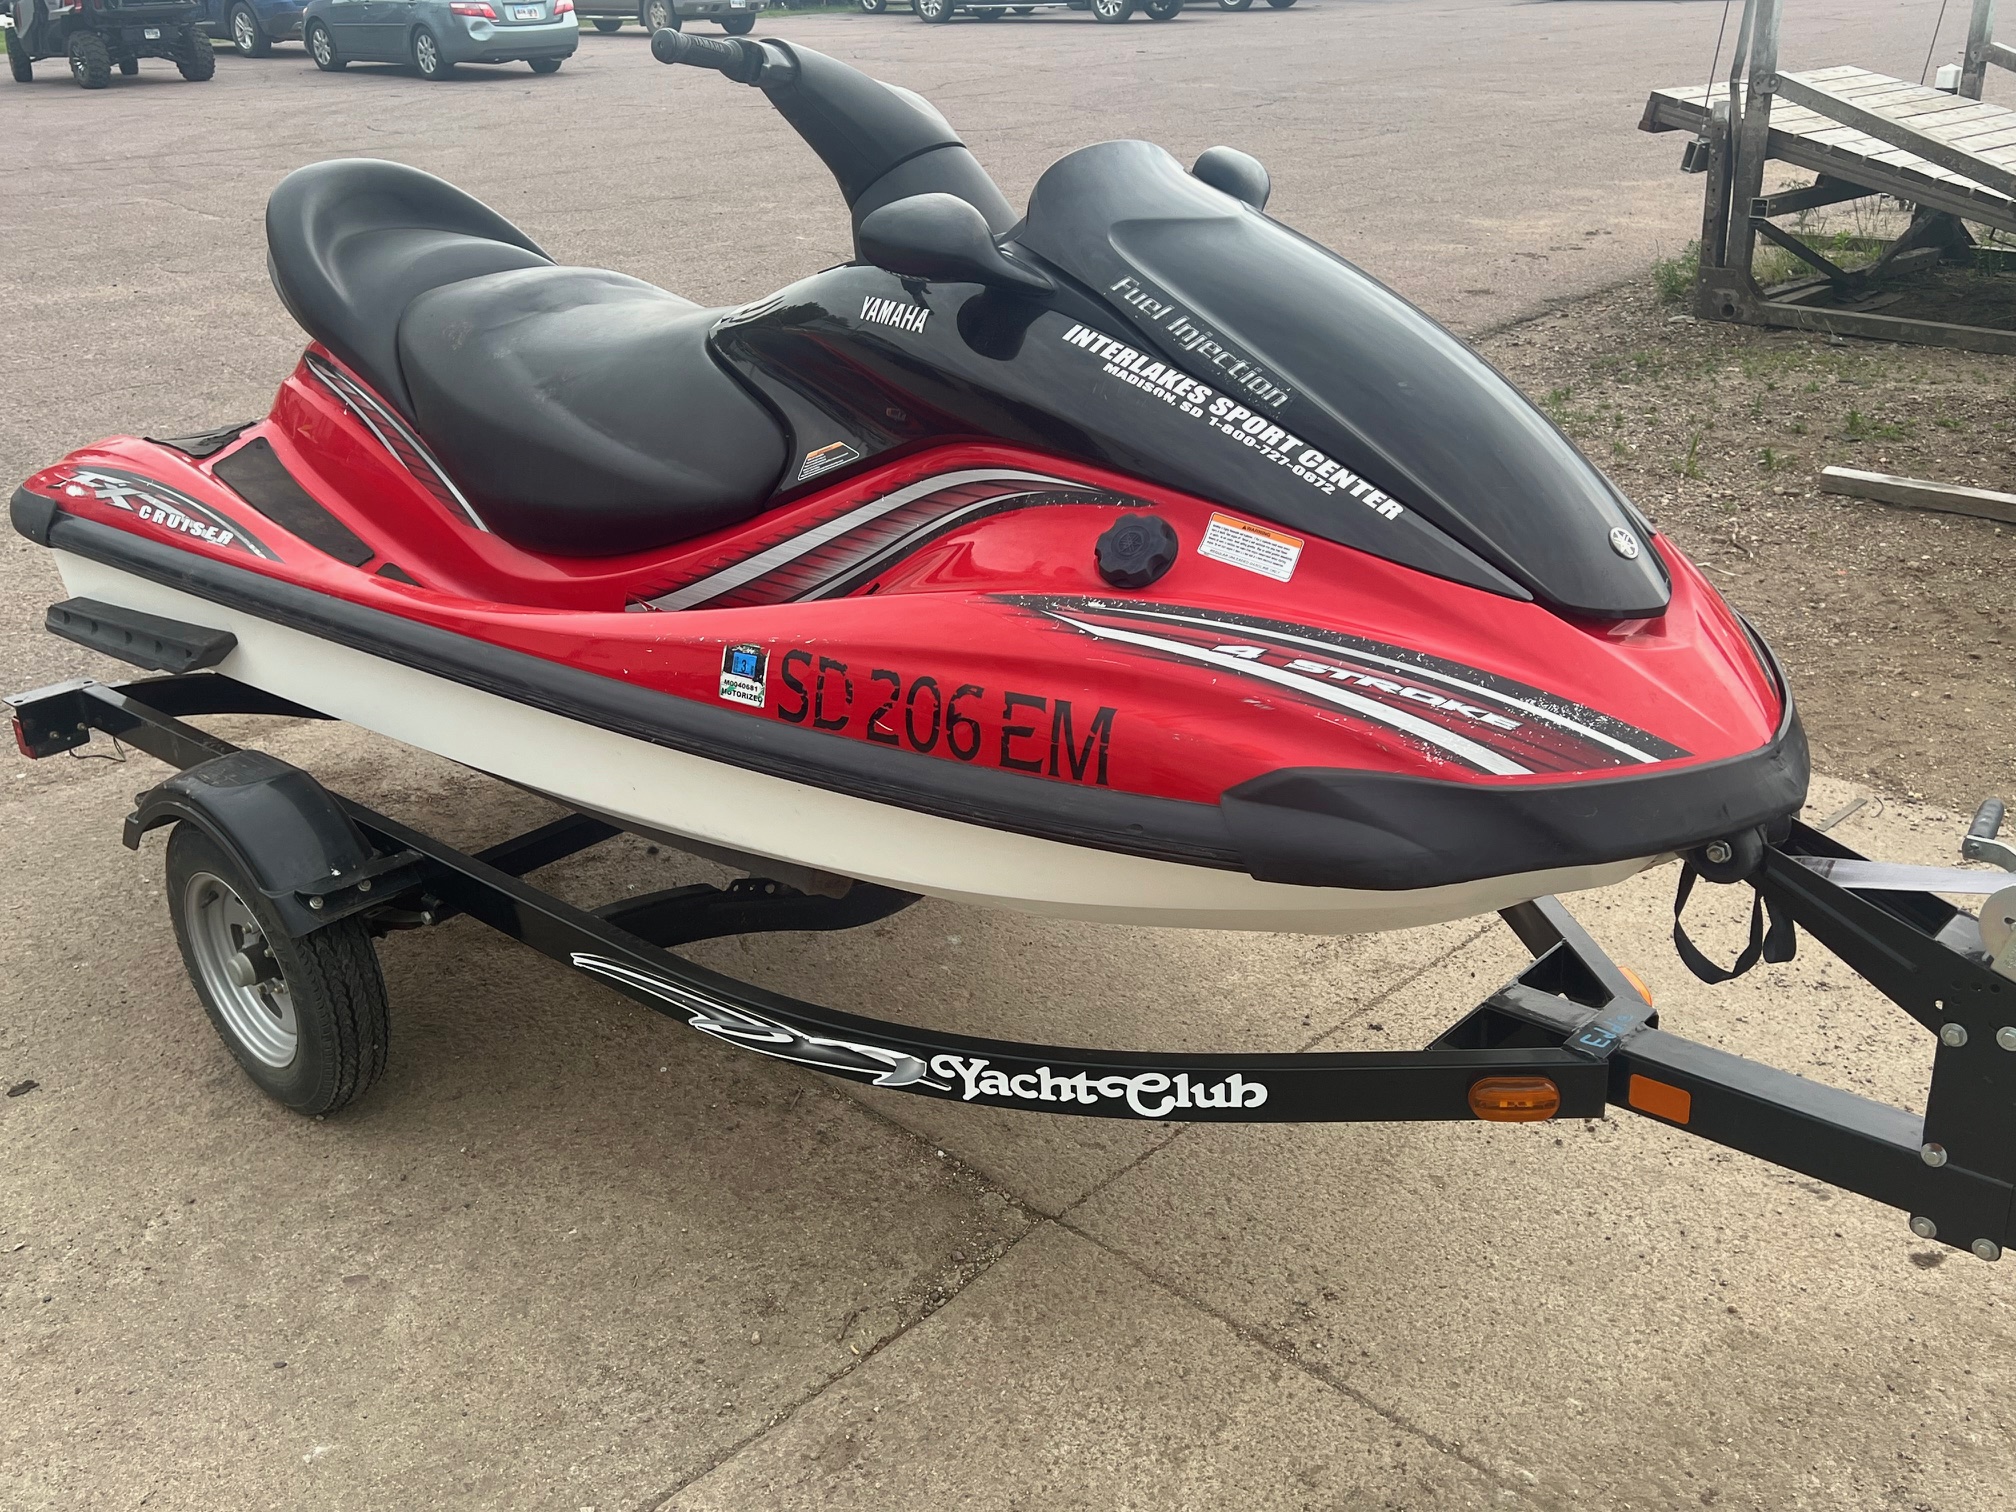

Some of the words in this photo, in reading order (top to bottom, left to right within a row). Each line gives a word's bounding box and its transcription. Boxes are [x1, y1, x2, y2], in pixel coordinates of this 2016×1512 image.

[860, 295, 931, 334] YAMAHA
[1110, 275, 1176, 321] Fuel
[1166, 314, 1290, 409] Injection
[1061, 323, 1213, 404] INTERLAKES
[1208, 396, 1304, 454] SPORT
[1297, 449, 1405, 521] CENTER
[1102, 362, 1177, 406] MADISON,
[1179, 400, 1205, 419] SD
[1208, 416, 1337, 496] 1-800-727-0672
[138, 505, 235, 546] CRUISER
[1246, 526, 1271, 538] WARNING
[741, 659, 748, 673] 3
[1212, 644, 1271, 660] 4
[1282, 658, 1526, 732] STROKE
[777, 649, 854, 732] SD
[866, 668, 985, 762] 206
[999, 691, 1118, 786] EM
[930, 1054, 1099, 1104] Yacht
[1098, 1072, 1268, 1117] Club
